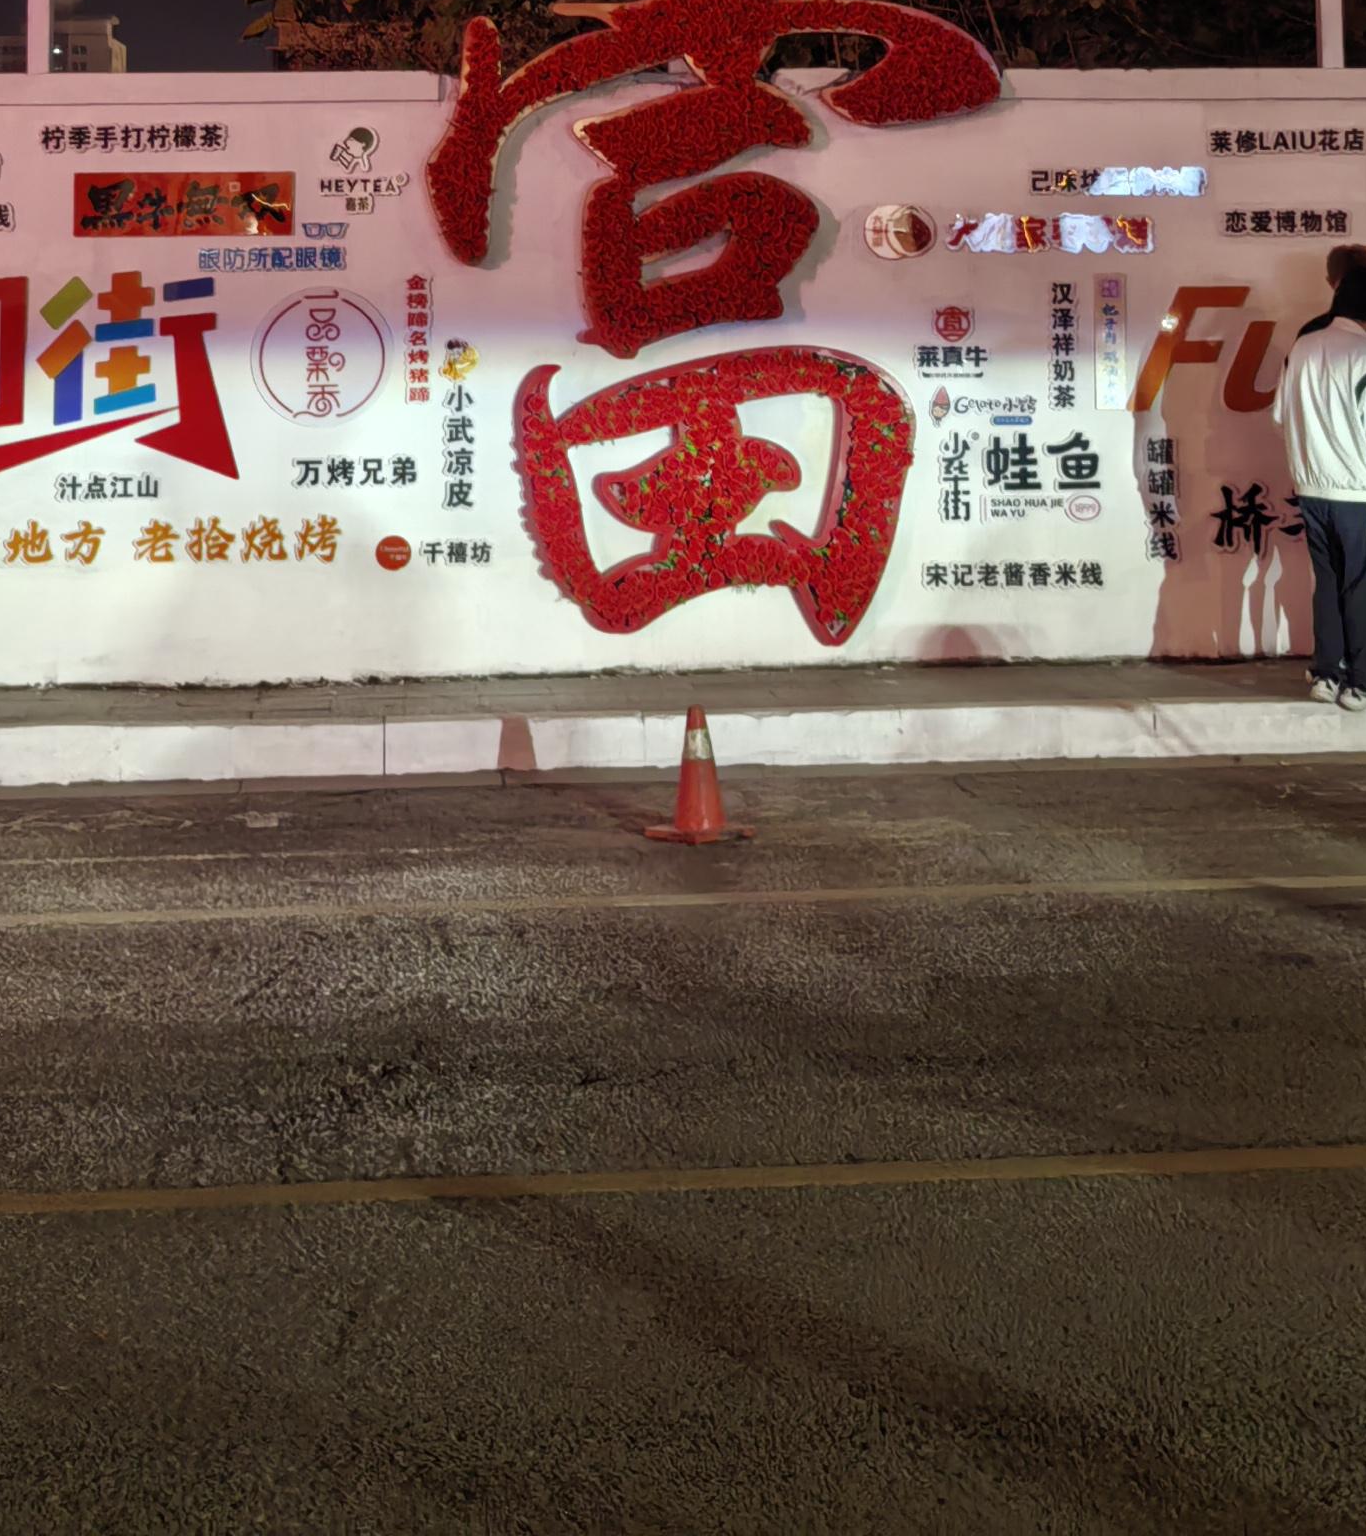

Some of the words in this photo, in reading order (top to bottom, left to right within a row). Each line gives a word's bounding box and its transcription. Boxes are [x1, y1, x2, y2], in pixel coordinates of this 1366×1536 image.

[41, 125, 223, 149] 柠季手打柠檬茶
[1210, 130, 1364, 151] 莱修LAIU花店
[320, 180, 395, 193] HEYTEA
[1224, 211, 1347, 233] 恋爱博物馆
[199, 248, 343, 270] 眼防所配眼镜
[407, 275, 429, 402] 金榜蹄名烤猪蹄
[1052, 283, 1075, 407] 汉泽祥奶茶
[917, 346, 987, 368] 莱真牛
[447, 386, 474, 507] 小武凉皮
[297, 457, 417, 486] 万烤兄弟
[986, 432, 1100, 490] 蛙鱼
[59, 476, 158, 498] 汁点江山
[1024, 498, 1047, 507] HUA
[1147, 438, 1177, 559] 罐罐米线
[991, 509, 1007, 518] WA
[1011, 509, 1025, 518] YU
[424, 541, 491, 563] 千禧坊
[926, 563, 1102, 587] 宋记老酱香米线
